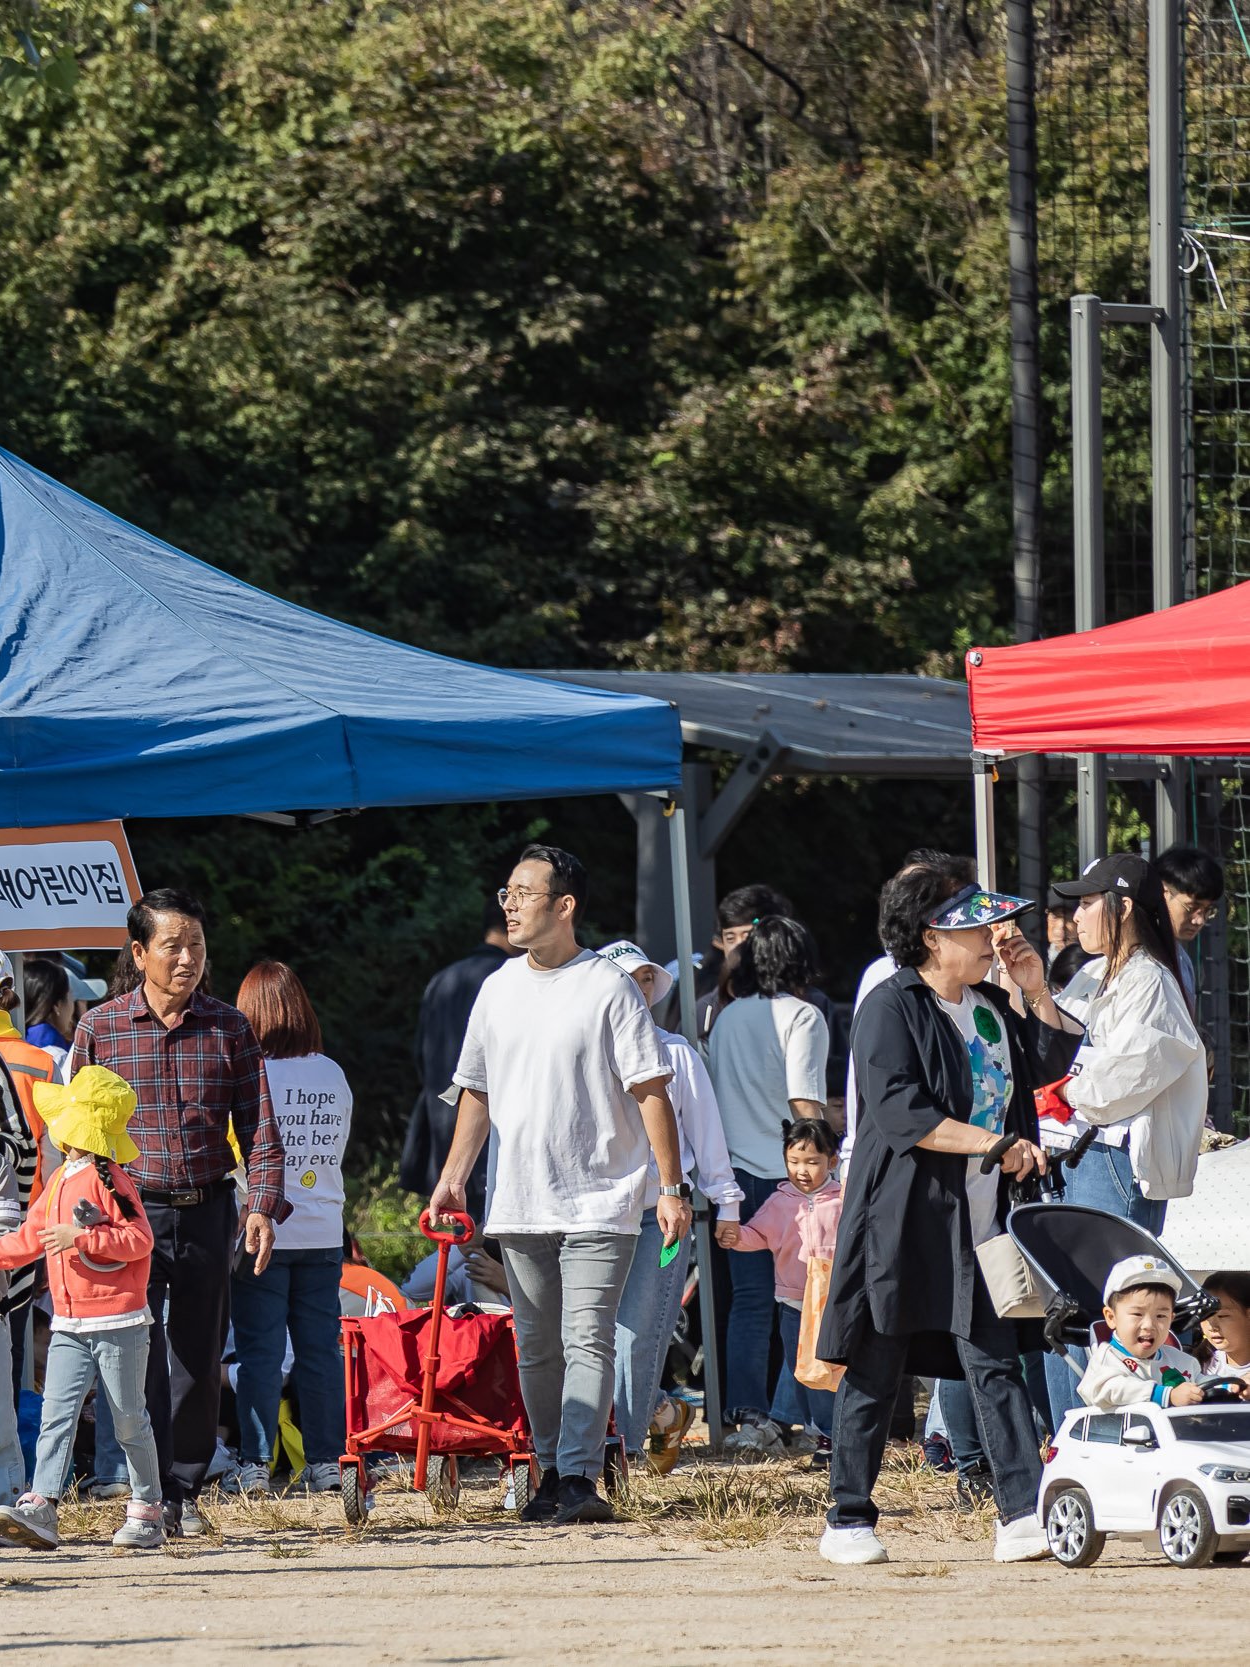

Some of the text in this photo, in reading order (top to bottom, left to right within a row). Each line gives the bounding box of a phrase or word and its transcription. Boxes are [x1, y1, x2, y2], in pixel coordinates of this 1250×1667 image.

[284, 1088, 336, 1109] I hope
[276, 1109, 342, 1128] you have
[285, 1151, 338, 1171] ay eve
